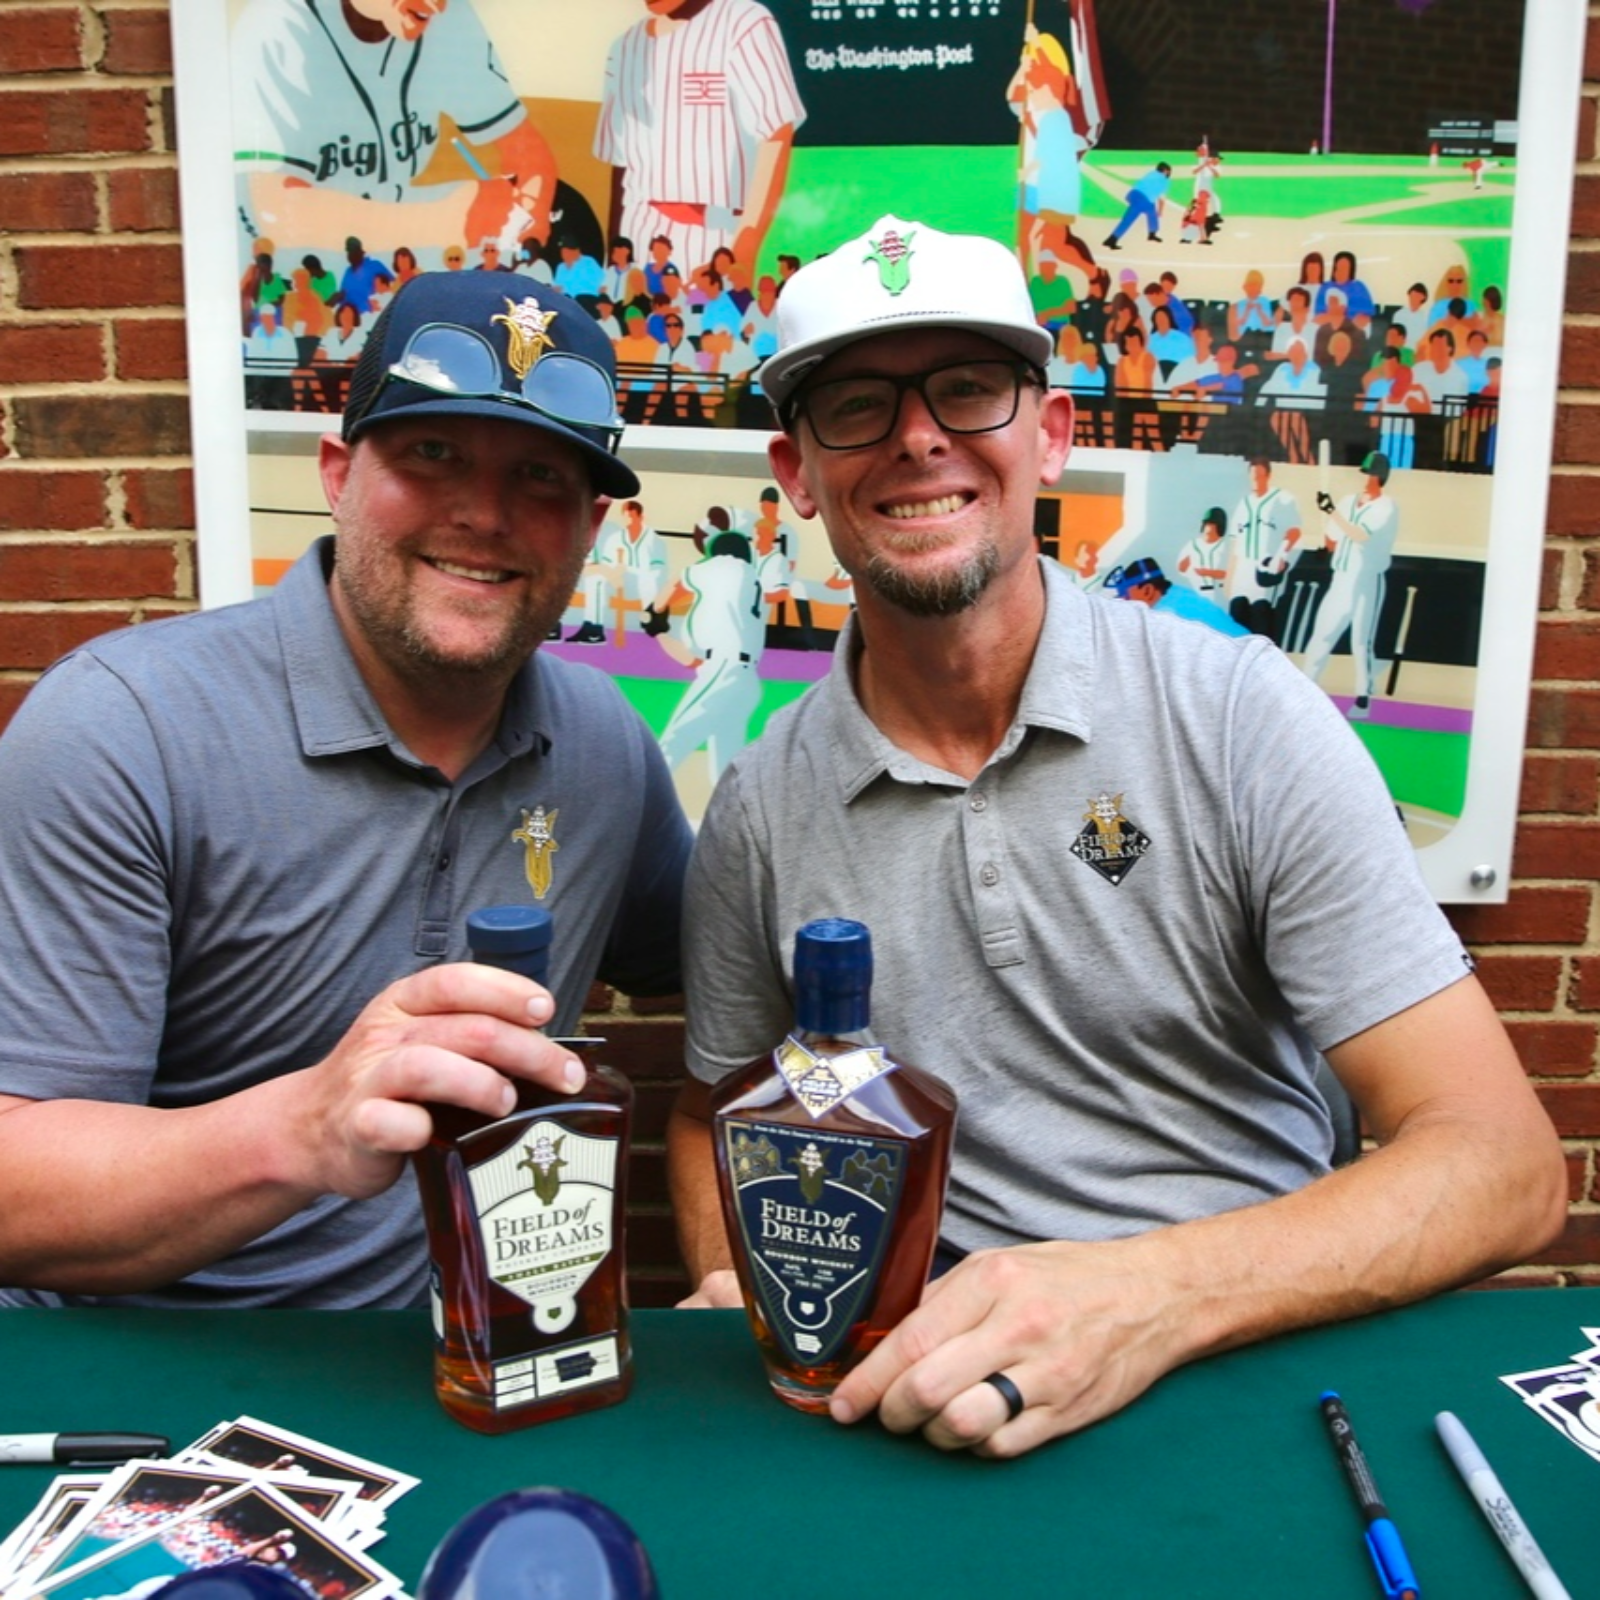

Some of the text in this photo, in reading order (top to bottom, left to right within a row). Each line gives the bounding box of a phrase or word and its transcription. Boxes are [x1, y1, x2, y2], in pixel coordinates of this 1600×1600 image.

[805, 43, 973, 71] The Washington Post
[316, 134, 378, 182] Big
[1081, 843, 1147, 862] DREAMS
[493, 1197, 597, 1239] FIELD of
[761, 1198, 857, 1234] FIELD of
[495, 1221, 604, 1262] DREAMS
[761, 1218, 861, 1252] DREAMS
[811, 1258, 854, 1269] WHISKEY
